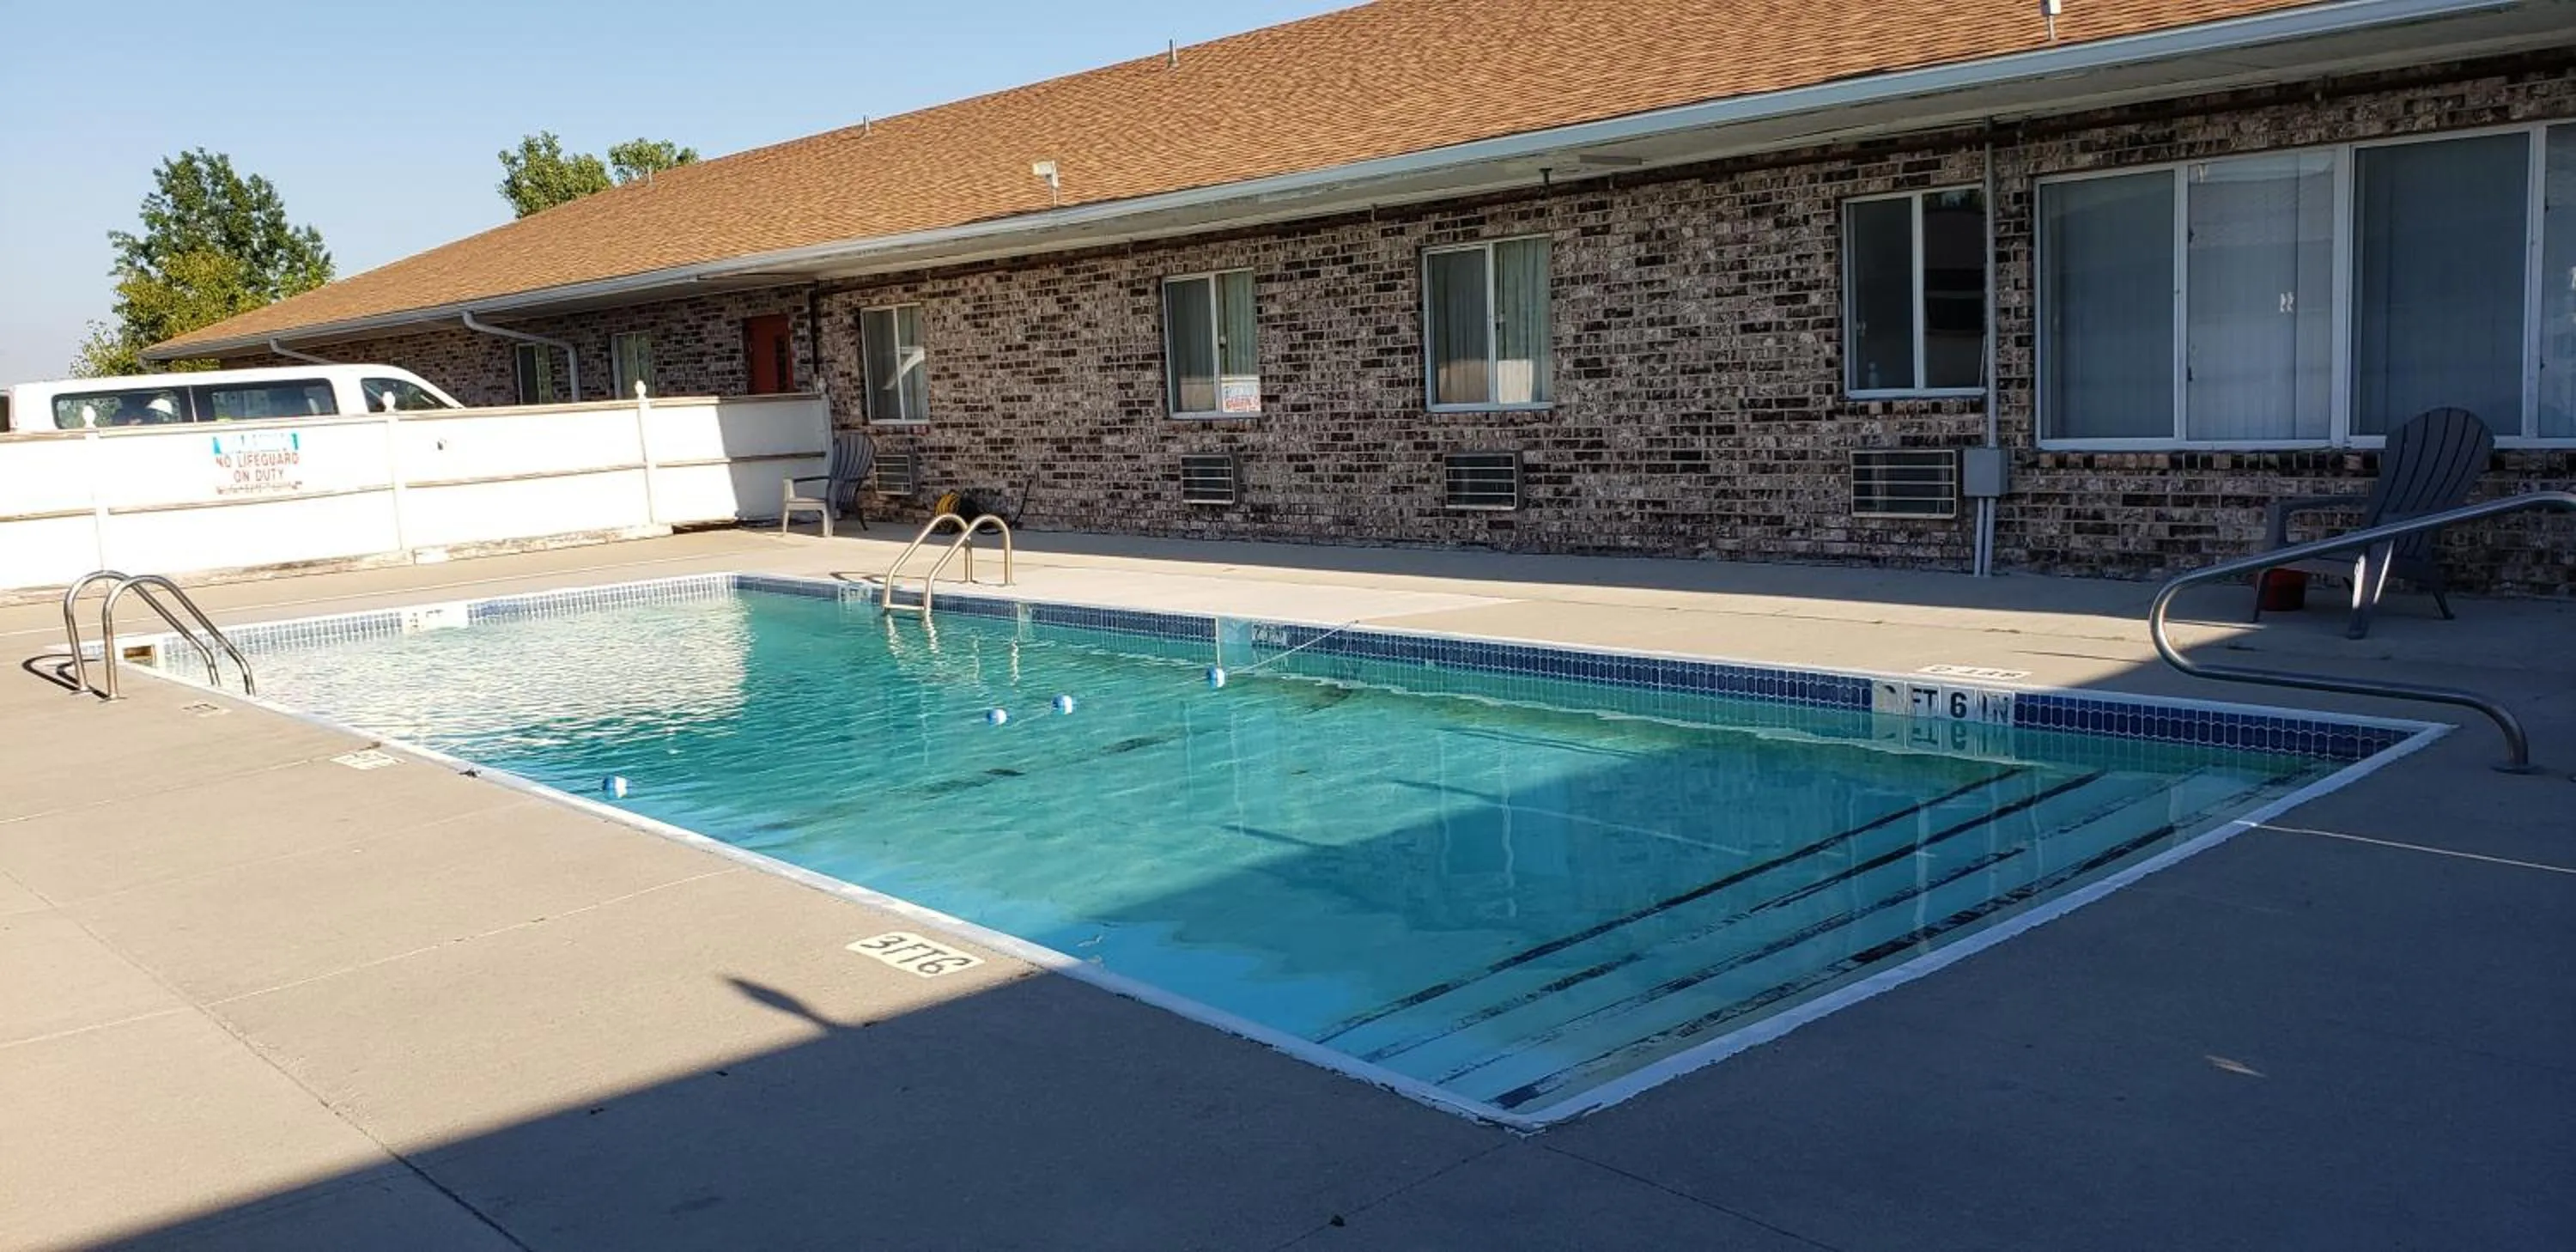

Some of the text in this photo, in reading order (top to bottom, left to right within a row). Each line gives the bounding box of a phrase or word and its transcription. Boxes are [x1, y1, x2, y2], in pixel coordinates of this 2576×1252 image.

[236, 452, 300, 468] LIFEGUARD
[233, 467, 285, 483] ON DUTY
[1912, 687, 1938, 718] FT
[1950, 691, 1968, 719] 6
[1981, 694, 2010, 723] IN
